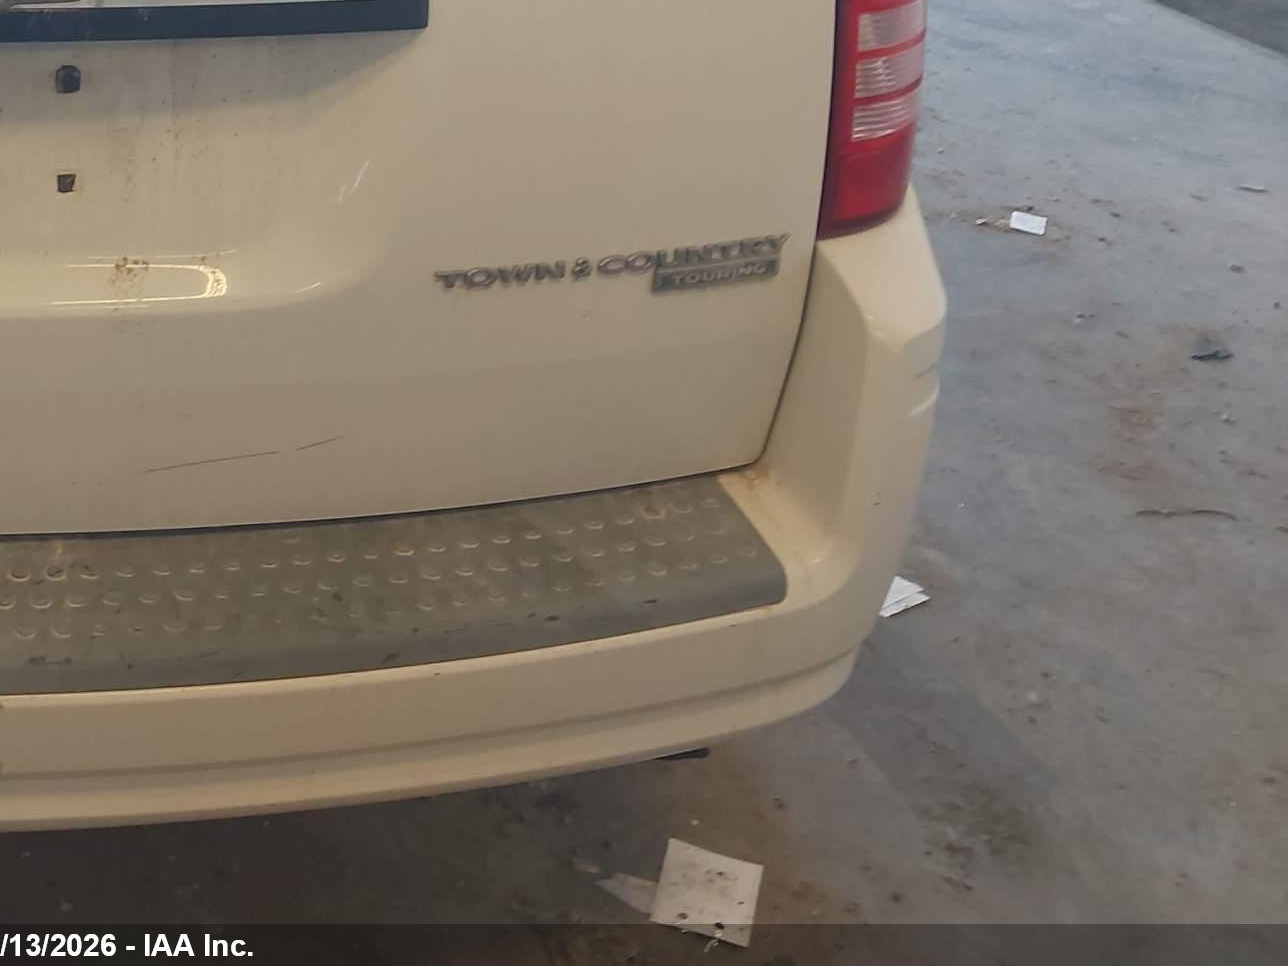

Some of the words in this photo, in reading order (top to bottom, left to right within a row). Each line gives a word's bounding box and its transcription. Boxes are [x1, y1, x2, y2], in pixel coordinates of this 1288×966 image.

[433, 259, 567, 290] TOWN
[571, 257, 592, 279] &
[597, 232, 793, 276] COUNTRY
[672, 263, 768, 286] TOURING
